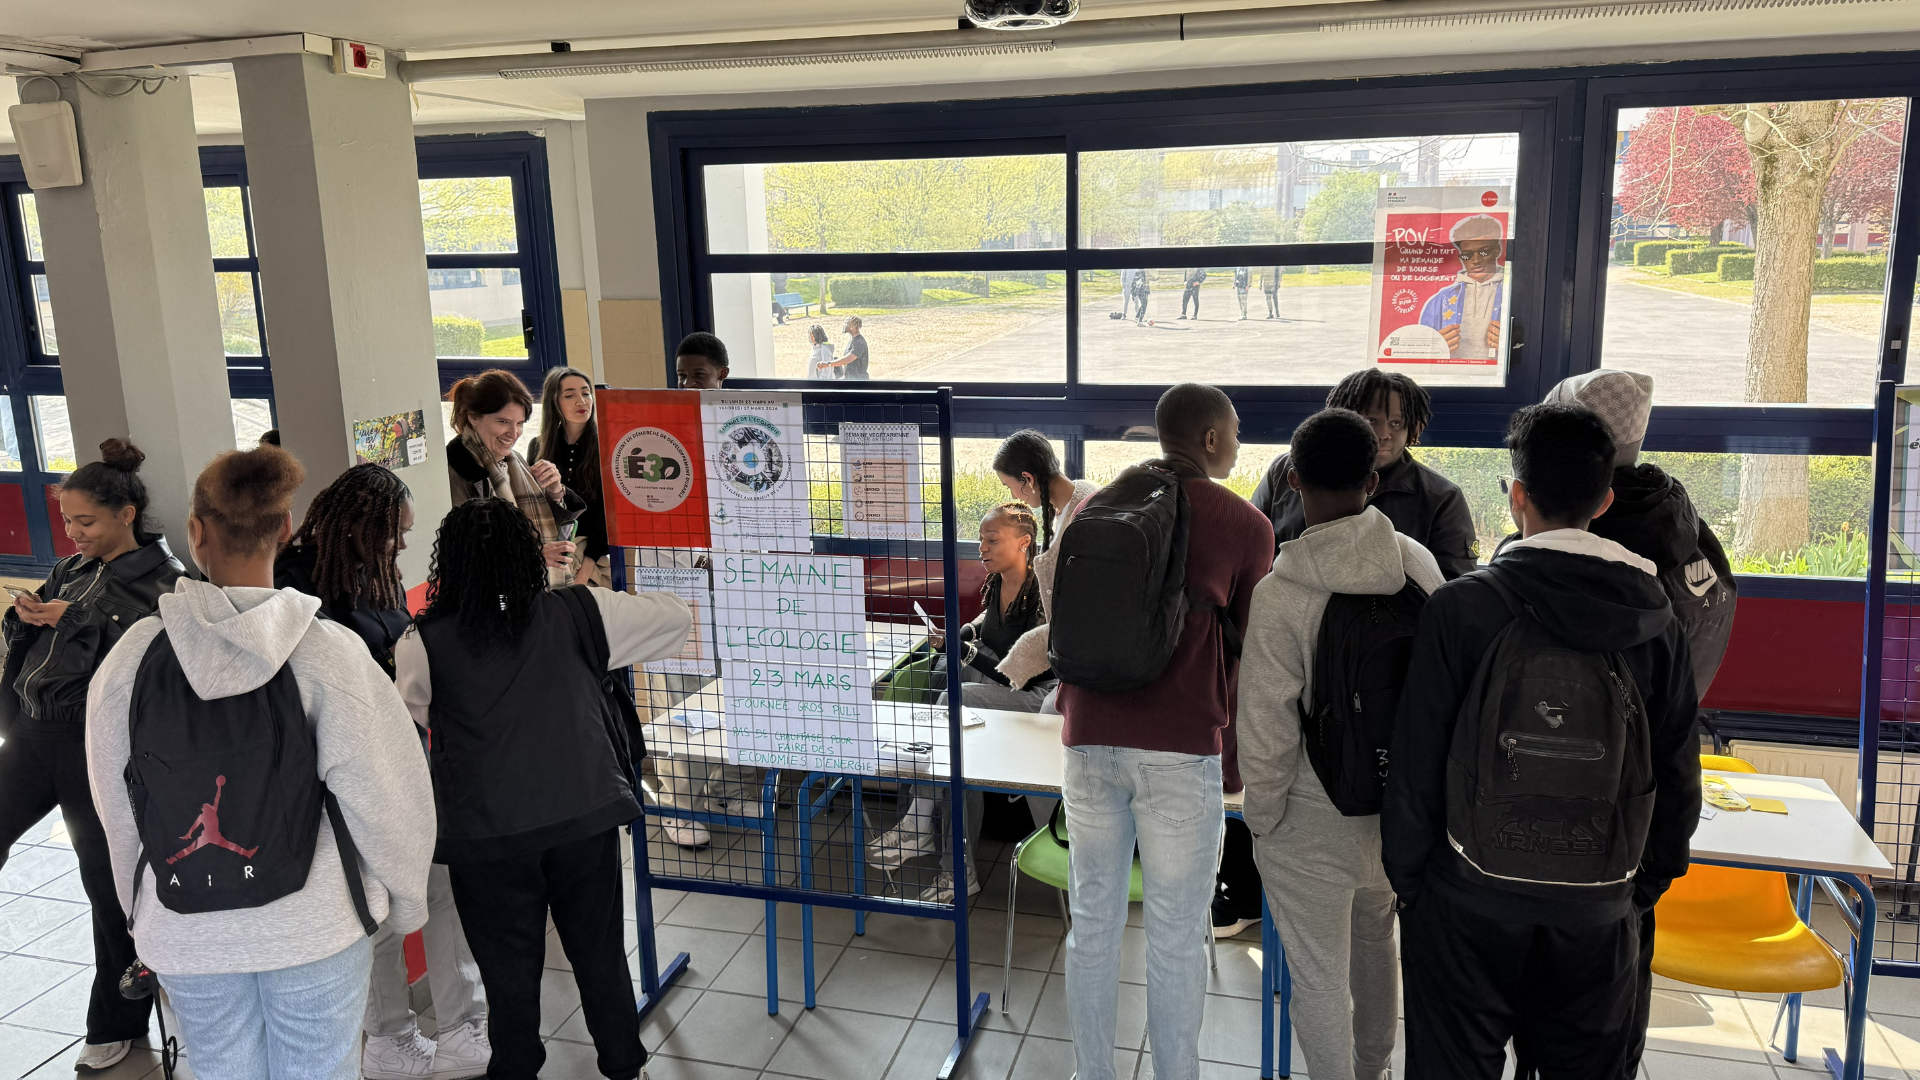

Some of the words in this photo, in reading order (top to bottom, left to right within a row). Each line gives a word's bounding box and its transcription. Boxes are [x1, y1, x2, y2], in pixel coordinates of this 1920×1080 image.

[1392, 227, 1429, 249] POV
[1399, 246, 1423, 255] QUAND
[1424, 246, 1438, 255] J'AI
[622, 456, 630, 479] LABEL
[723, 557, 852, 590] SEMAINE
[1684, 558, 1716, 584] NIK
[775, 598, 807, 616] DE
[1702, 592, 1727, 608] AIR
[725, 625, 858, 654] L'ECOLOGIE
[751, 668, 783, 688] 23
[794, 670, 852, 691] MARS
[731, 697, 790, 711] JOURNÉE
[797, 701, 824, 713] GROS
[832, 705, 861, 717] PULL
[732, 726, 750, 737] PAS
[755, 729, 768, 739] DE
[775, 731, 823, 743] CHAUFFAGE
[831, 735, 853, 745] POUR
[778, 743, 808, 753] FAIRE
[811, 745, 835, 755] DES
[170, 865, 255, 887] AIR
